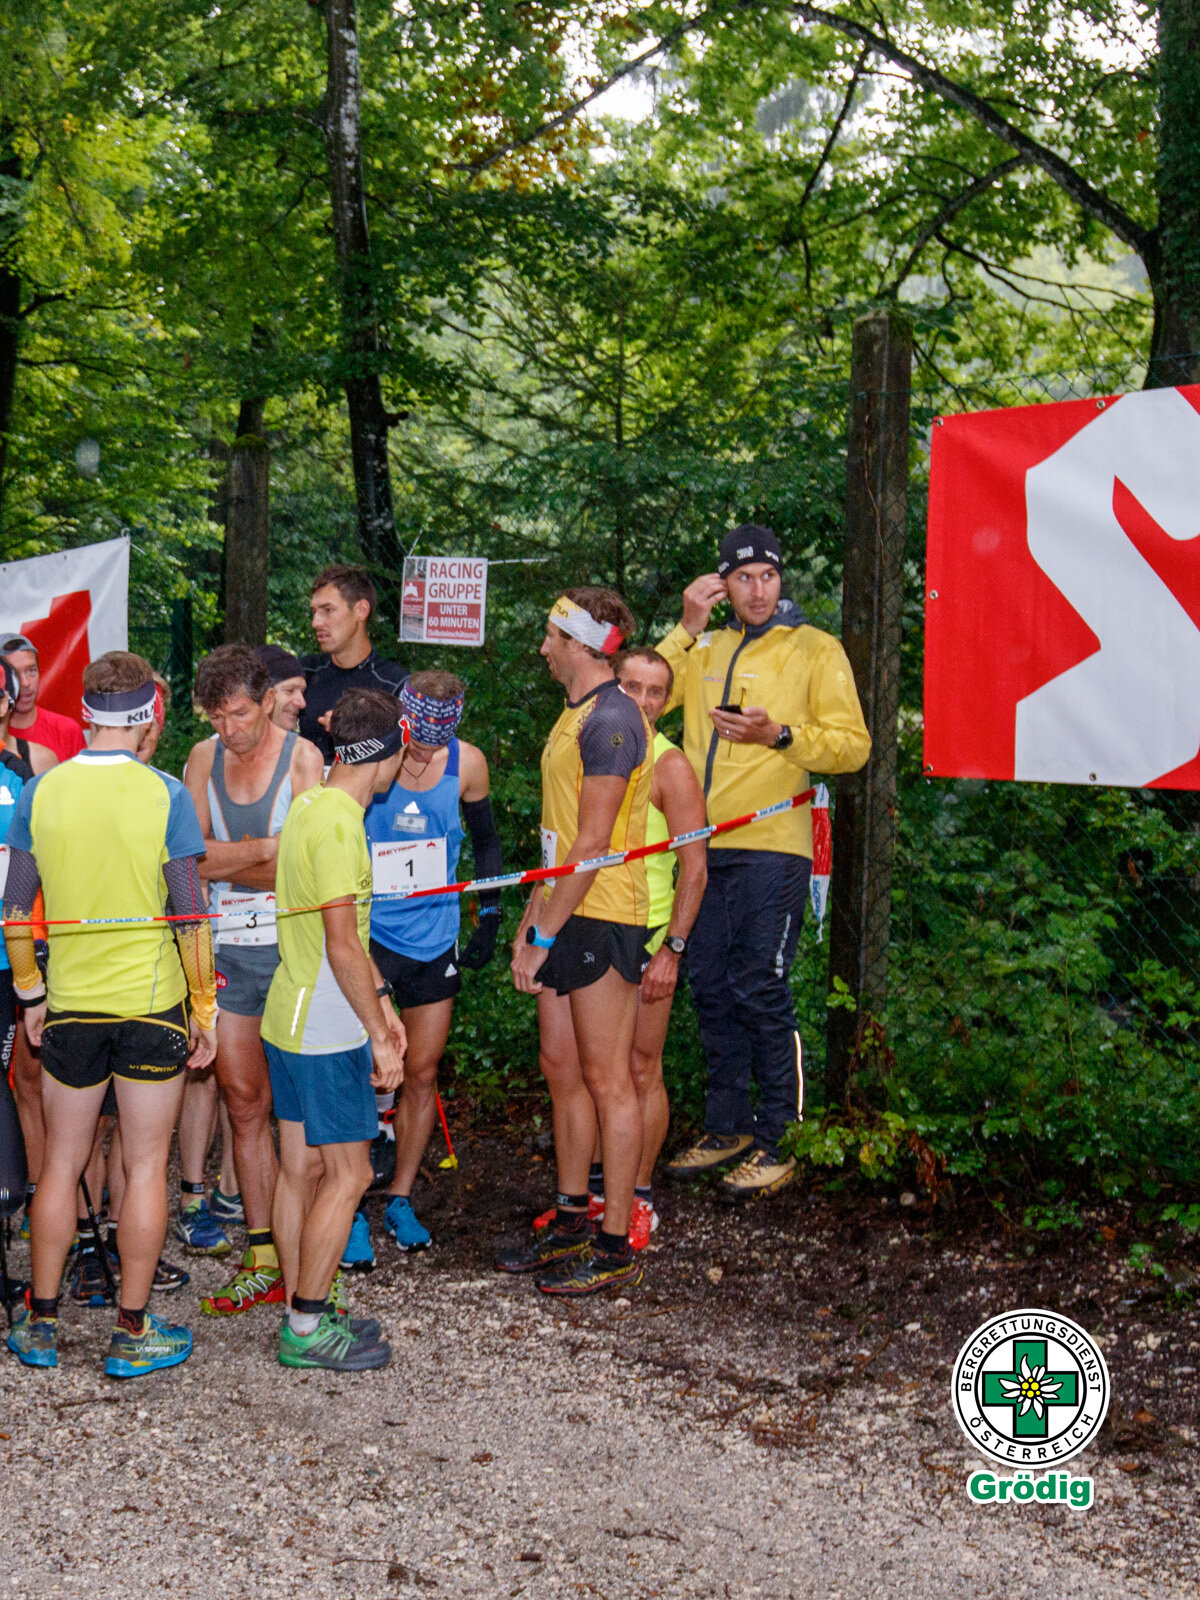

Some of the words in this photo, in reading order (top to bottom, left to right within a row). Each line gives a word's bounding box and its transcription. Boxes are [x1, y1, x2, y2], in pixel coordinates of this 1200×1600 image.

[429, 562, 483, 579] RACING
[428, 582, 482, 600] GRUPPE
[439, 604, 468, 616] UNTER
[428, 616, 439, 628] 60
[440, 617, 480, 629] MINUTEN
[127, 703, 154, 724] KIL
[404, 859, 414, 877] 1
[245, 909, 258, 929] 3
